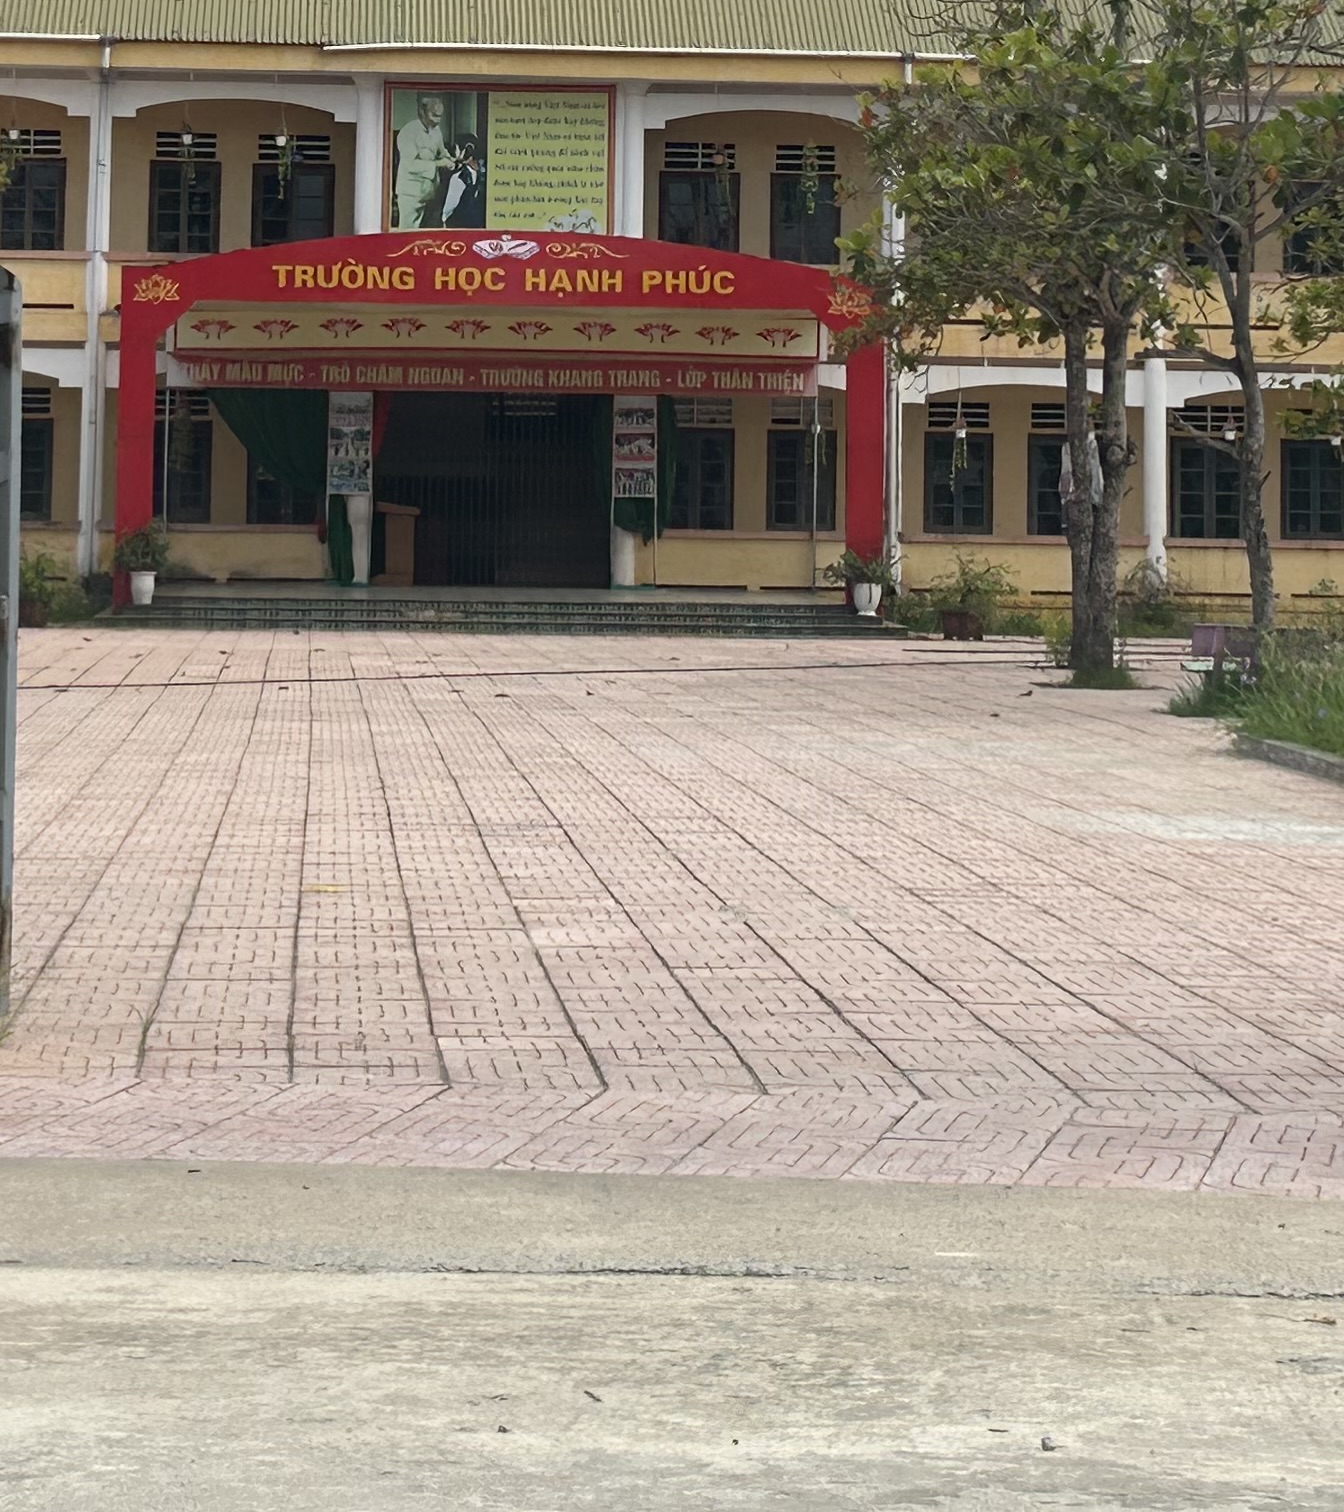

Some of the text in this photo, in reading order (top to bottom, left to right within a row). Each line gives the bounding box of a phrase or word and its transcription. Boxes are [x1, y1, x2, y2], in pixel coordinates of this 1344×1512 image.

[272, 258, 735, 297] TRƯỜNG HỌC HẠNH PHÚC
[548, 369, 603, 387] KHANG
[608, 369, 660, 388] TRANG
[712, 367, 753, 388] THÂN
